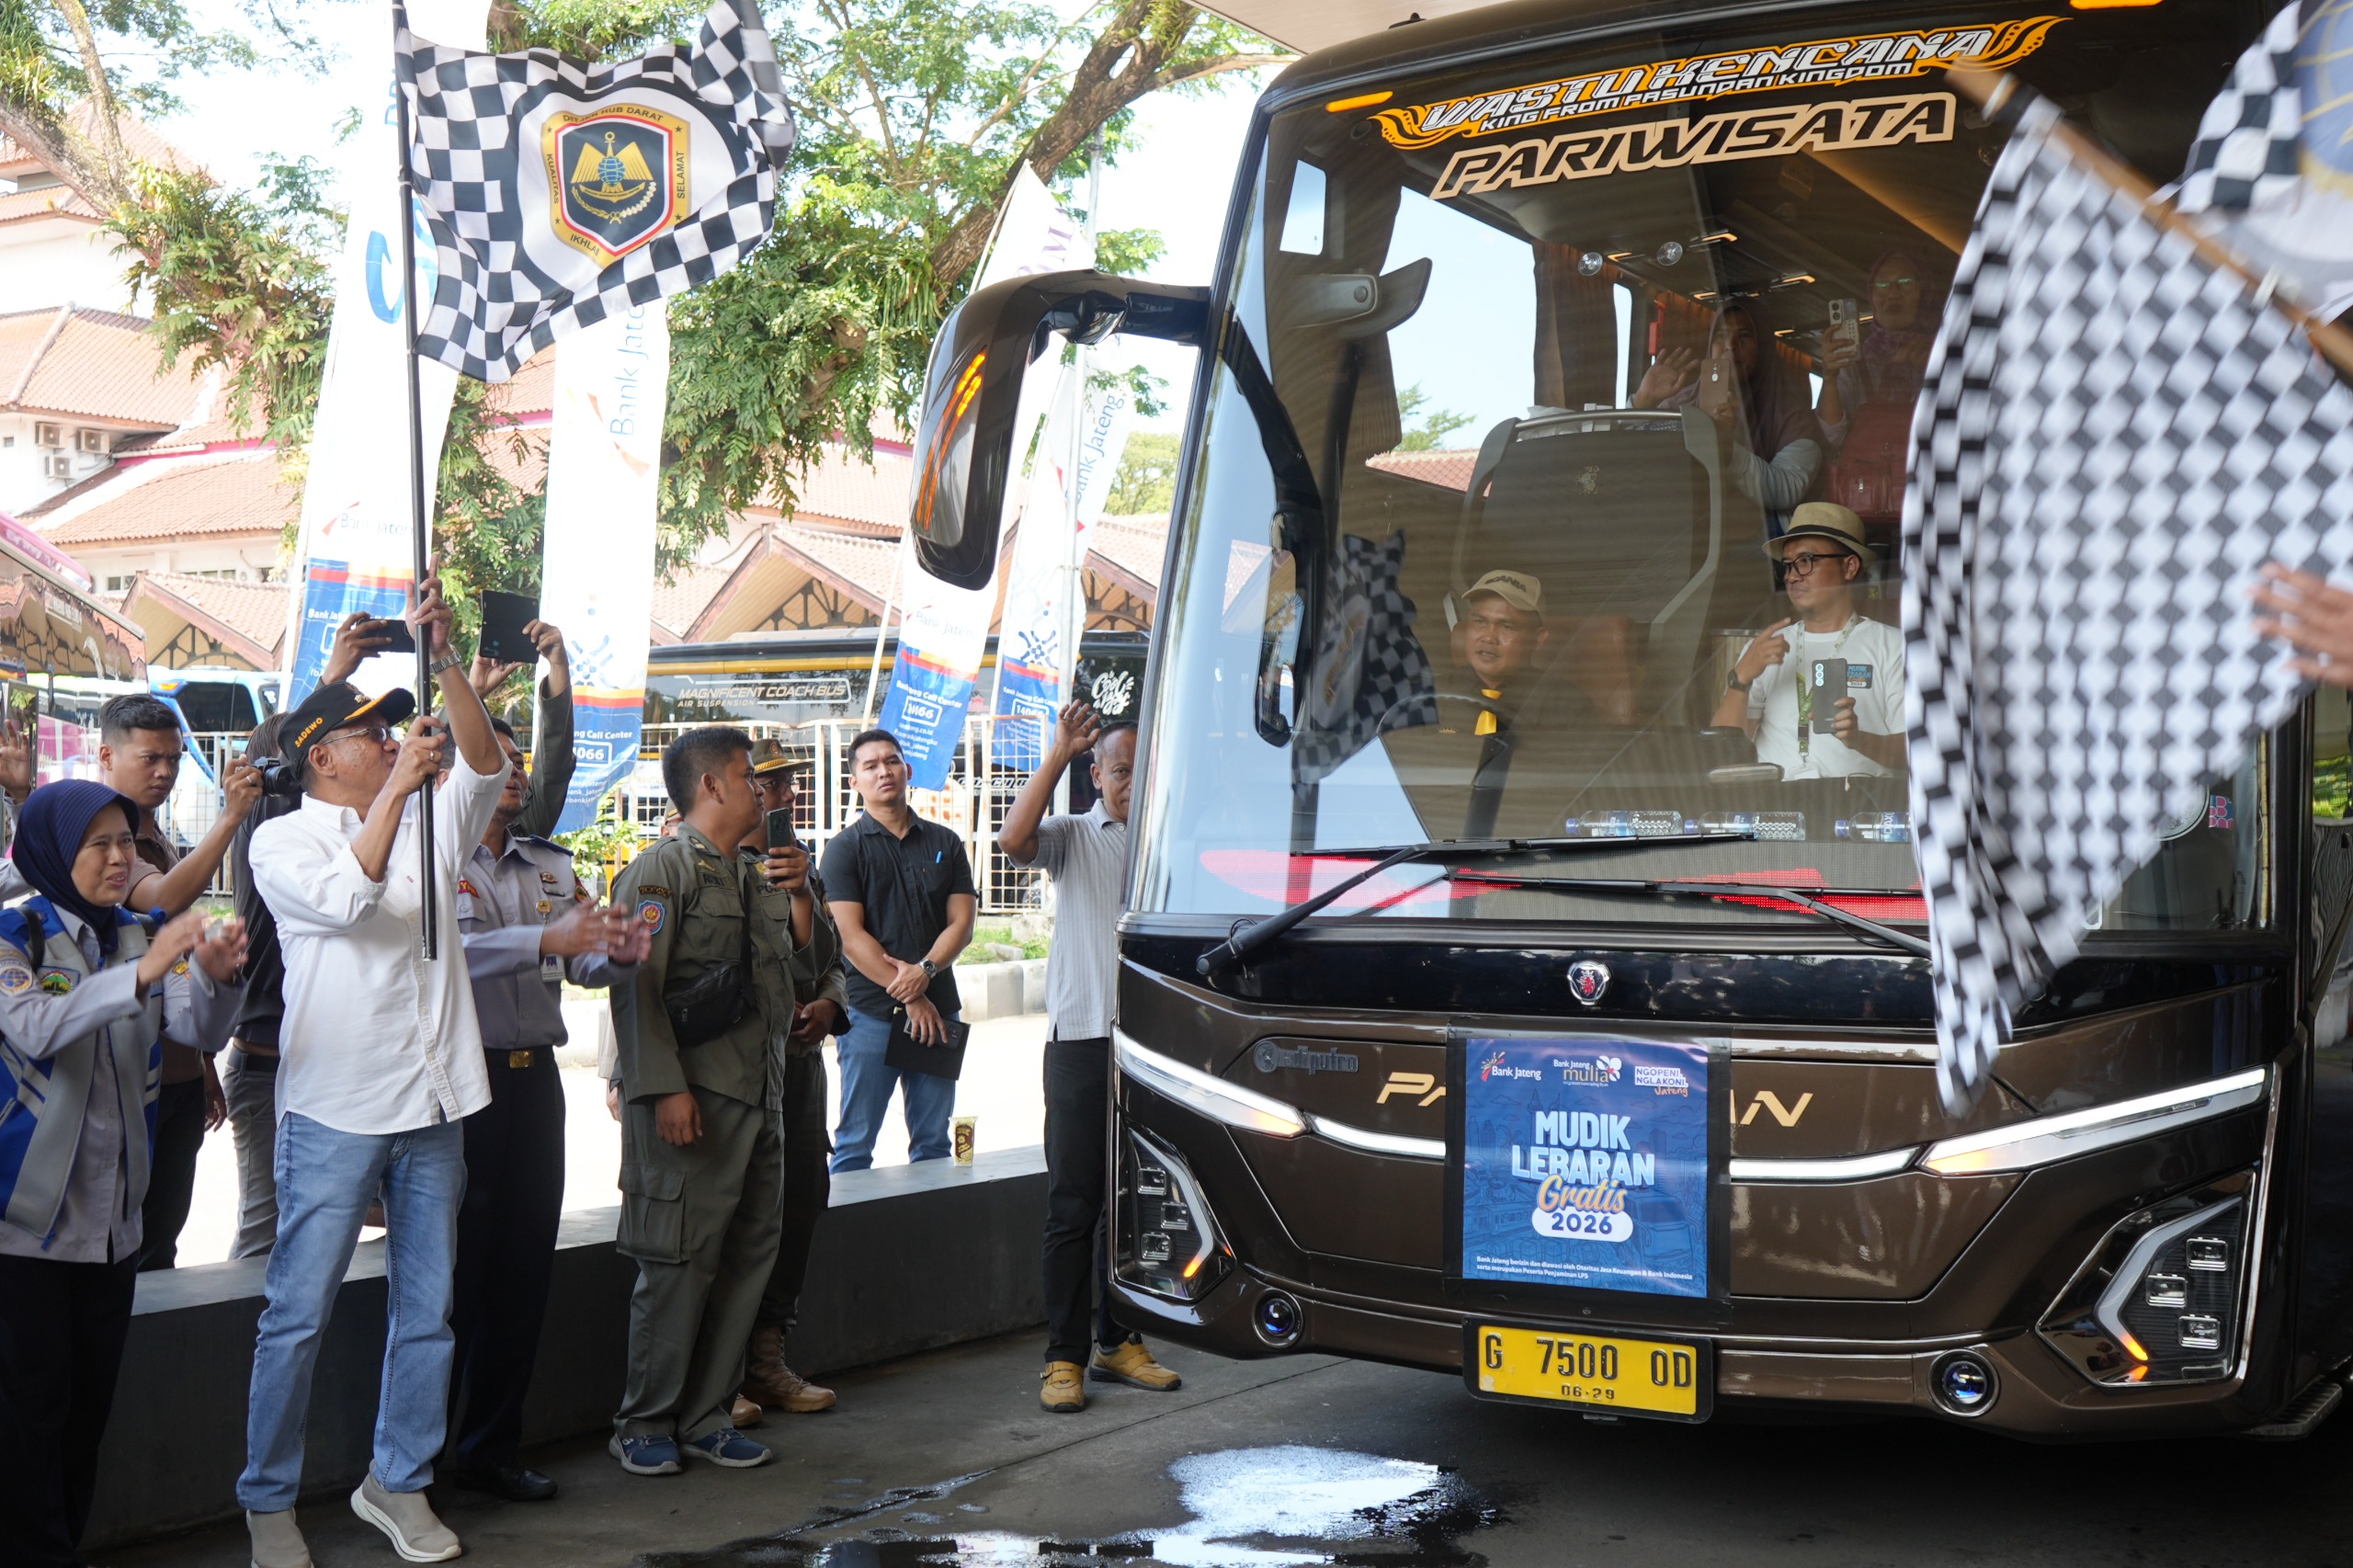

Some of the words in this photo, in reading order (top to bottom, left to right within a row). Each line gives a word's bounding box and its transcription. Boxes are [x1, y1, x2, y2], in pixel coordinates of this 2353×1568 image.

[1421, 69, 1645, 132] WASTU
[1649, 29, 1994, 90] KENCANA
[1480, 113, 1540, 132] KING
[1542, 97, 1620, 120] FROM
[1623, 74, 1773, 107] PASUNDAN
[1778, 62, 1914, 86] KINGDOM
[562, 111, 599, 123] DITJEN
[600, 106, 624, 115] HUB
[626, 106, 665, 122] DARAT
[1429, 92, 1957, 200] PARIWISATA
[546, 153, 560, 204] KUALITAS
[676, 151, 686, 199] SELAMAT
[569, 233, 601, 256] IKHLAS
[618, 302, 649, 361] Jate
[609, 367, 640, 436] Bank
[1084, 394, 1125, 459] Jateng
[677, 699, 694, 708] AIR
[697, 699, 756, 708] SUSPENSION
[678, 687, 766, 699] MAGNIFICENT
[766, 685, 814, 698] COACH
[815, 684, 847, 697] BUS
[294, 717, 324, 748] SADEWO
[586, 730, 604, 740] Call
[604, 731, 633, 740] Center
[573, 746, 605, 761] 066
[1492, 1065, 1514, 1076] Bank
[1514, 1066, 1542, 1081] Jateng
[1553, 1059, 1570, 1068] Bank
[1570, 1060, 1590, 1070] Jateng
[1563, 1065, 1609, 1083] mulia
[1654, 1084, 1689, 1098] Jateng
[1534, 1110, 1631, 1151] MUDIK
[1511, 1144, 1655, 1187] LEBARAN
[1537, 1174, 1629, 1214] Gratis
[1551, 1211, 1613, 1235] 2026
[1491, 1266, 1523, 1274] merupakan
[1492, 1257, 1509, 1266] Jateng
[1541, 1261, 1563, 1269] diawasi
[1575, 1264, 1599, 1272] Otoritas
[1612, 1267, 1642, 1277] Keuangan
[1664, 1272, 1693, 1280] Indonesia
[1484, 1333, 1504, 1369] G
[1535, 1335, 1619, 1381] 7500
